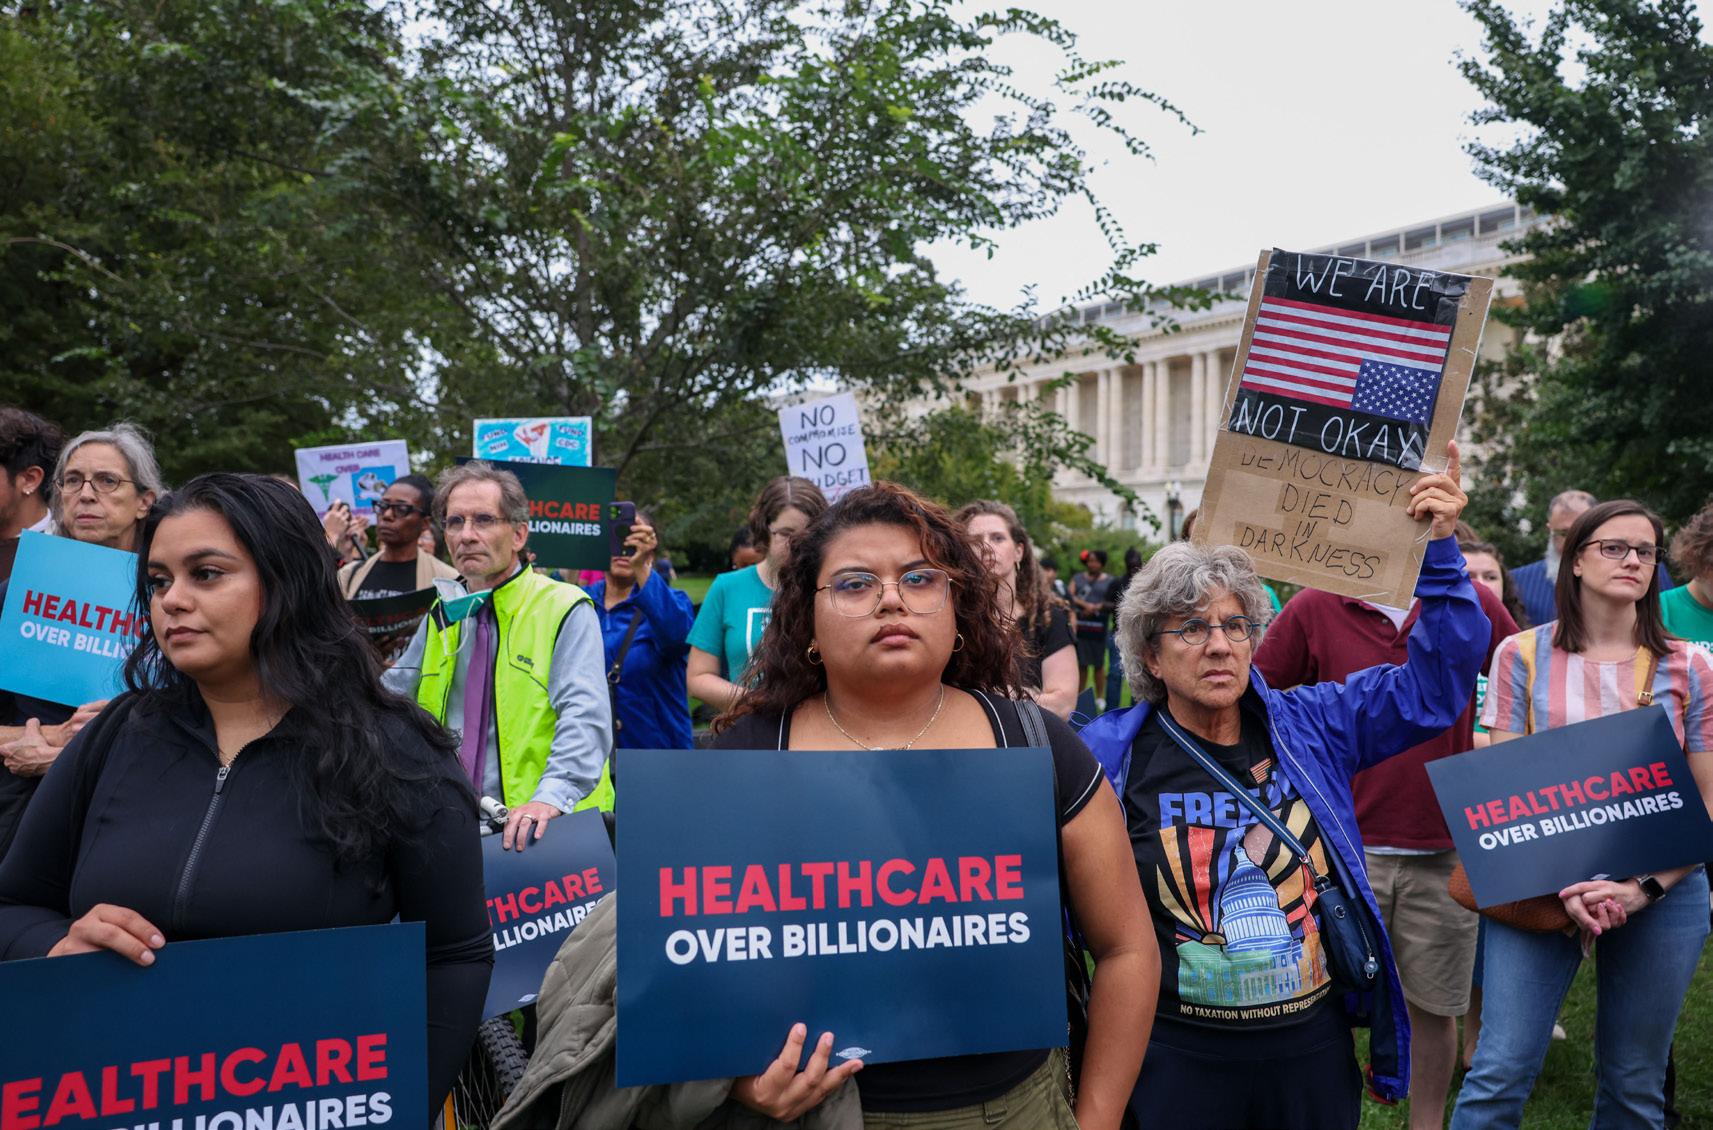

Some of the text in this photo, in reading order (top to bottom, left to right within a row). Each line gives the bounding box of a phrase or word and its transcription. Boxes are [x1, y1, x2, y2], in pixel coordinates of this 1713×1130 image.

[1296, 254, 1436, 310] WE ARE
[788, 423, 856, 445] COMPROMISE
[801, 404, 835, 430] NO
[1235, 397, 1418, 465] NOT OKAY
[320, 448, 380, 461] HEALTH CARE
[802, 442, 847, 472] NO
[1241, 448, 1413, 507] DEMOCRACY
[1281, 482, 1353, 526] DIED
[1240, 526, 1381, 579] DARKNESS
[1295, 520, 1318, 539] IN
[20, 620, 71, 648] OVER
[1464, 761, 1674, 831] HEALTHCARE
[1478, 791, 1684, 851] OVER BILLIONAIRES
[659, 854, 1025, 917] HEALTHCARE
[665, 911, 1031, 966] OVER BILLIONAIRES
[1179, 1003, 1193, 1015] NO
[1194, 1006, 1239, 1020] TAXATION
[1239, 1004, 1281, 1020] WITHOUT
